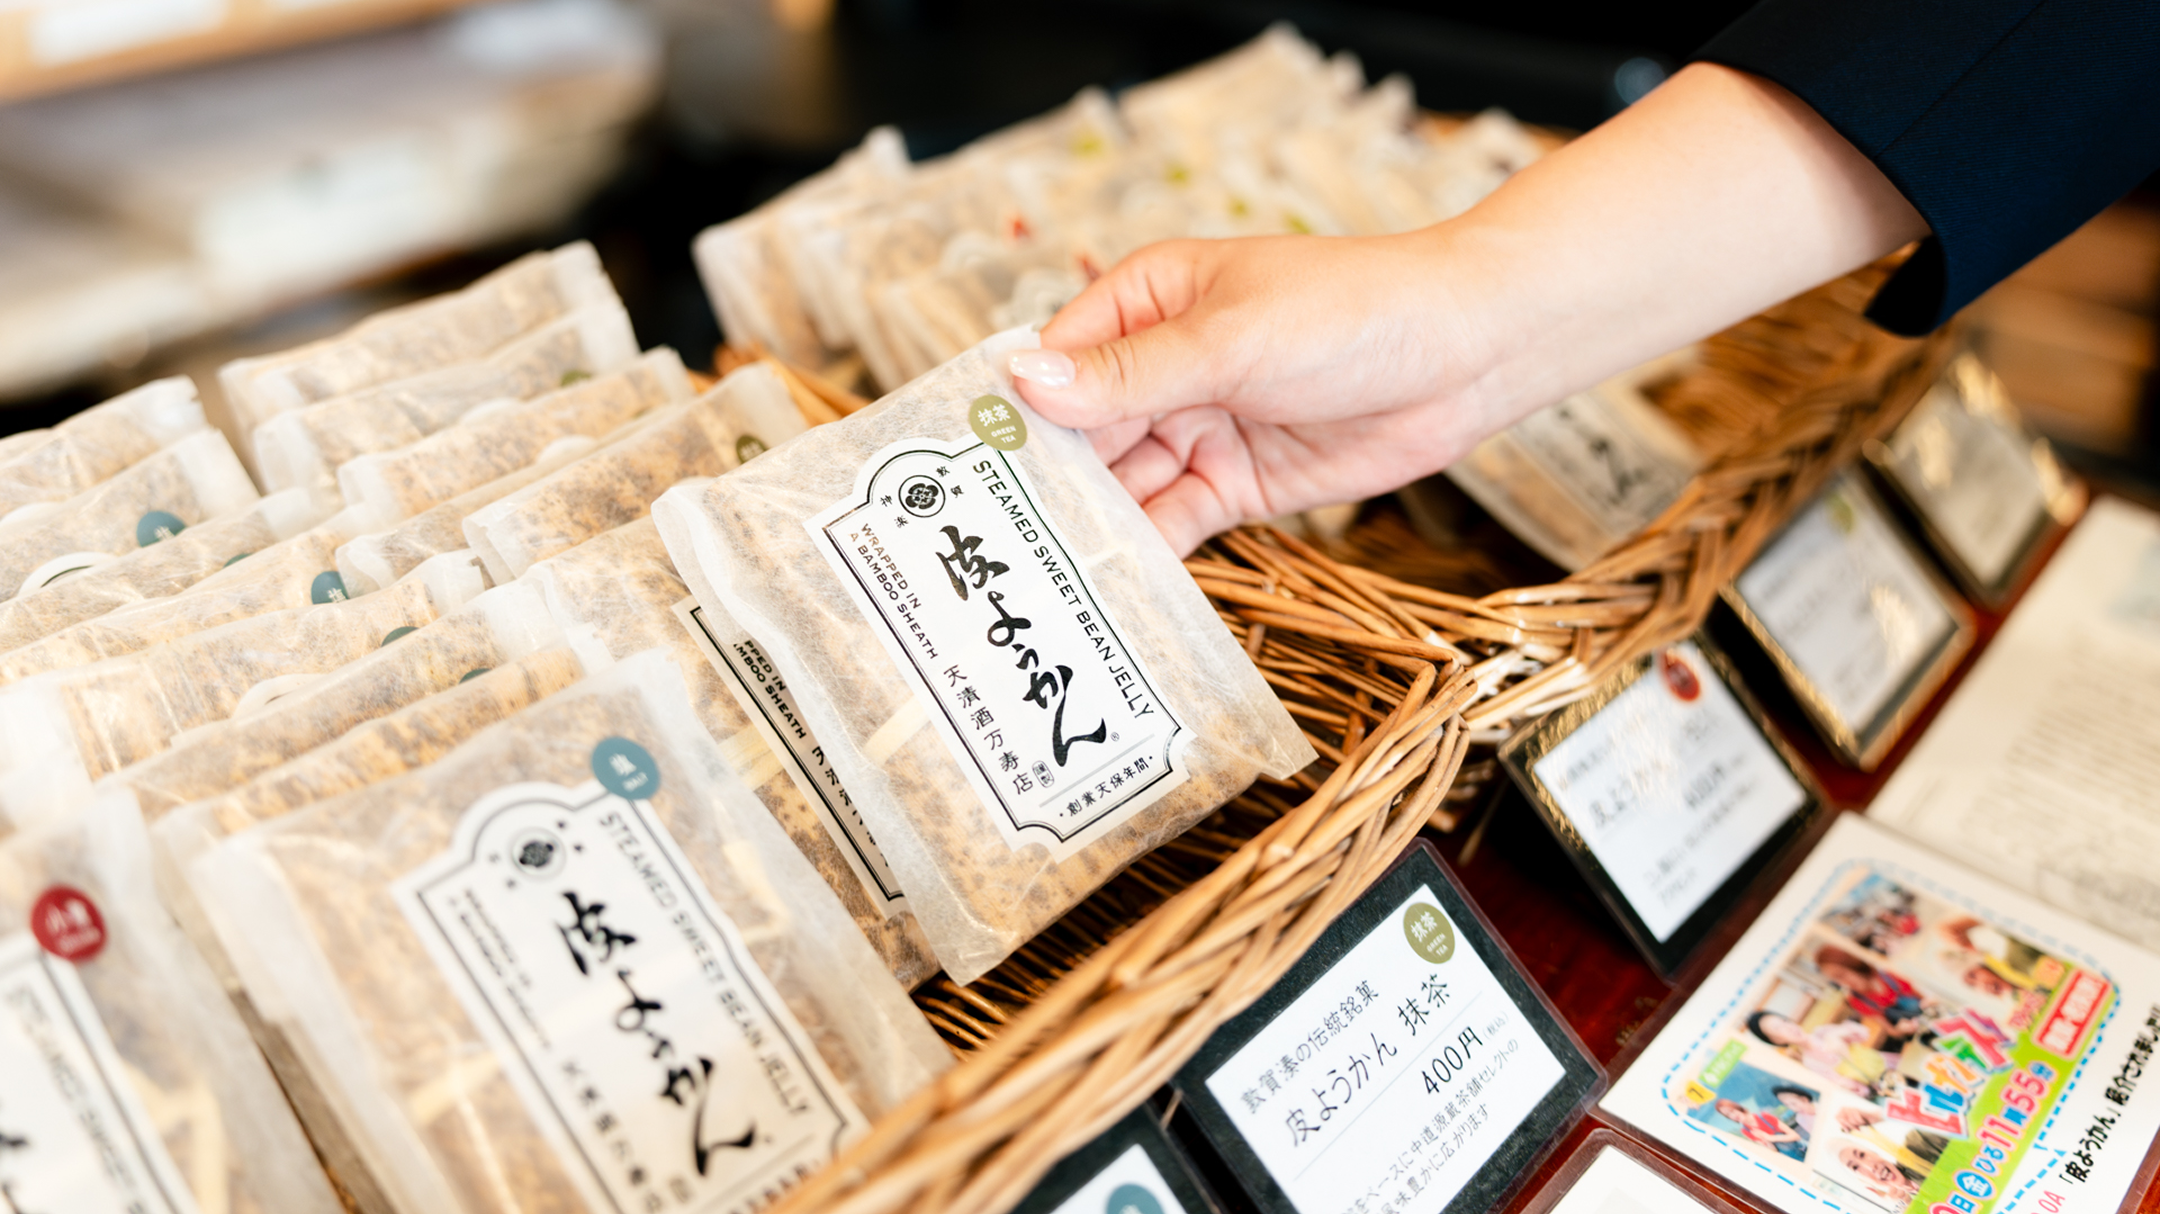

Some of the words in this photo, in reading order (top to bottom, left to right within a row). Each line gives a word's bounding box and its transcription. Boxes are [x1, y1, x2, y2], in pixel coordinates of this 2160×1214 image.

[977, 403, 1011, 426] 抹茶
[991, 426, 1016, 438] GREEN
[1001, 435, 1016, 444] TEA
[849, 532, 859, 542] A
[857, 544, 899, 600] BAMBOO
[897, 603, 938, 660] SHEATH
[861, 523, 908, 590] WRAPPED
[906, 593, 922, 609] IN
[973, 460, 1039, 543] STEAMED
[1033, 546, 1082, 606] SWEET
[1076, 610, 1116, 661] BEAN
[1109, 665, 1154, 718] JELLY
[733, 643, 766, 683] MBOO
[765, 685, 806, 739] SHEATH
[744, 639, 773, 675] PPED
[772, 675, 786, 691] IN
[935, 525, 1107, 767] 皮ようかん
[943, 664, 1034, 795] 天清酒万寿店
[600, 811, 678, 908] STEAMED
[1410, 911, 1438, 943] 抹茶
[1425, 933, 1446, 953] GREEN
[1436, 944, 1449, 957] TEA
[1240, 980, 1379, 1114] 敦賀湊の伝統銘菓
[1285, 1032, 1398, 1147] 皮ようかん
[1397, 973, 1451, 1037] 抹茶
[1421, 1026, 1483, 1095] 400円
[1348, 1038, 1519, 1214] をベースに中道源蔵茶舗セレクトの
